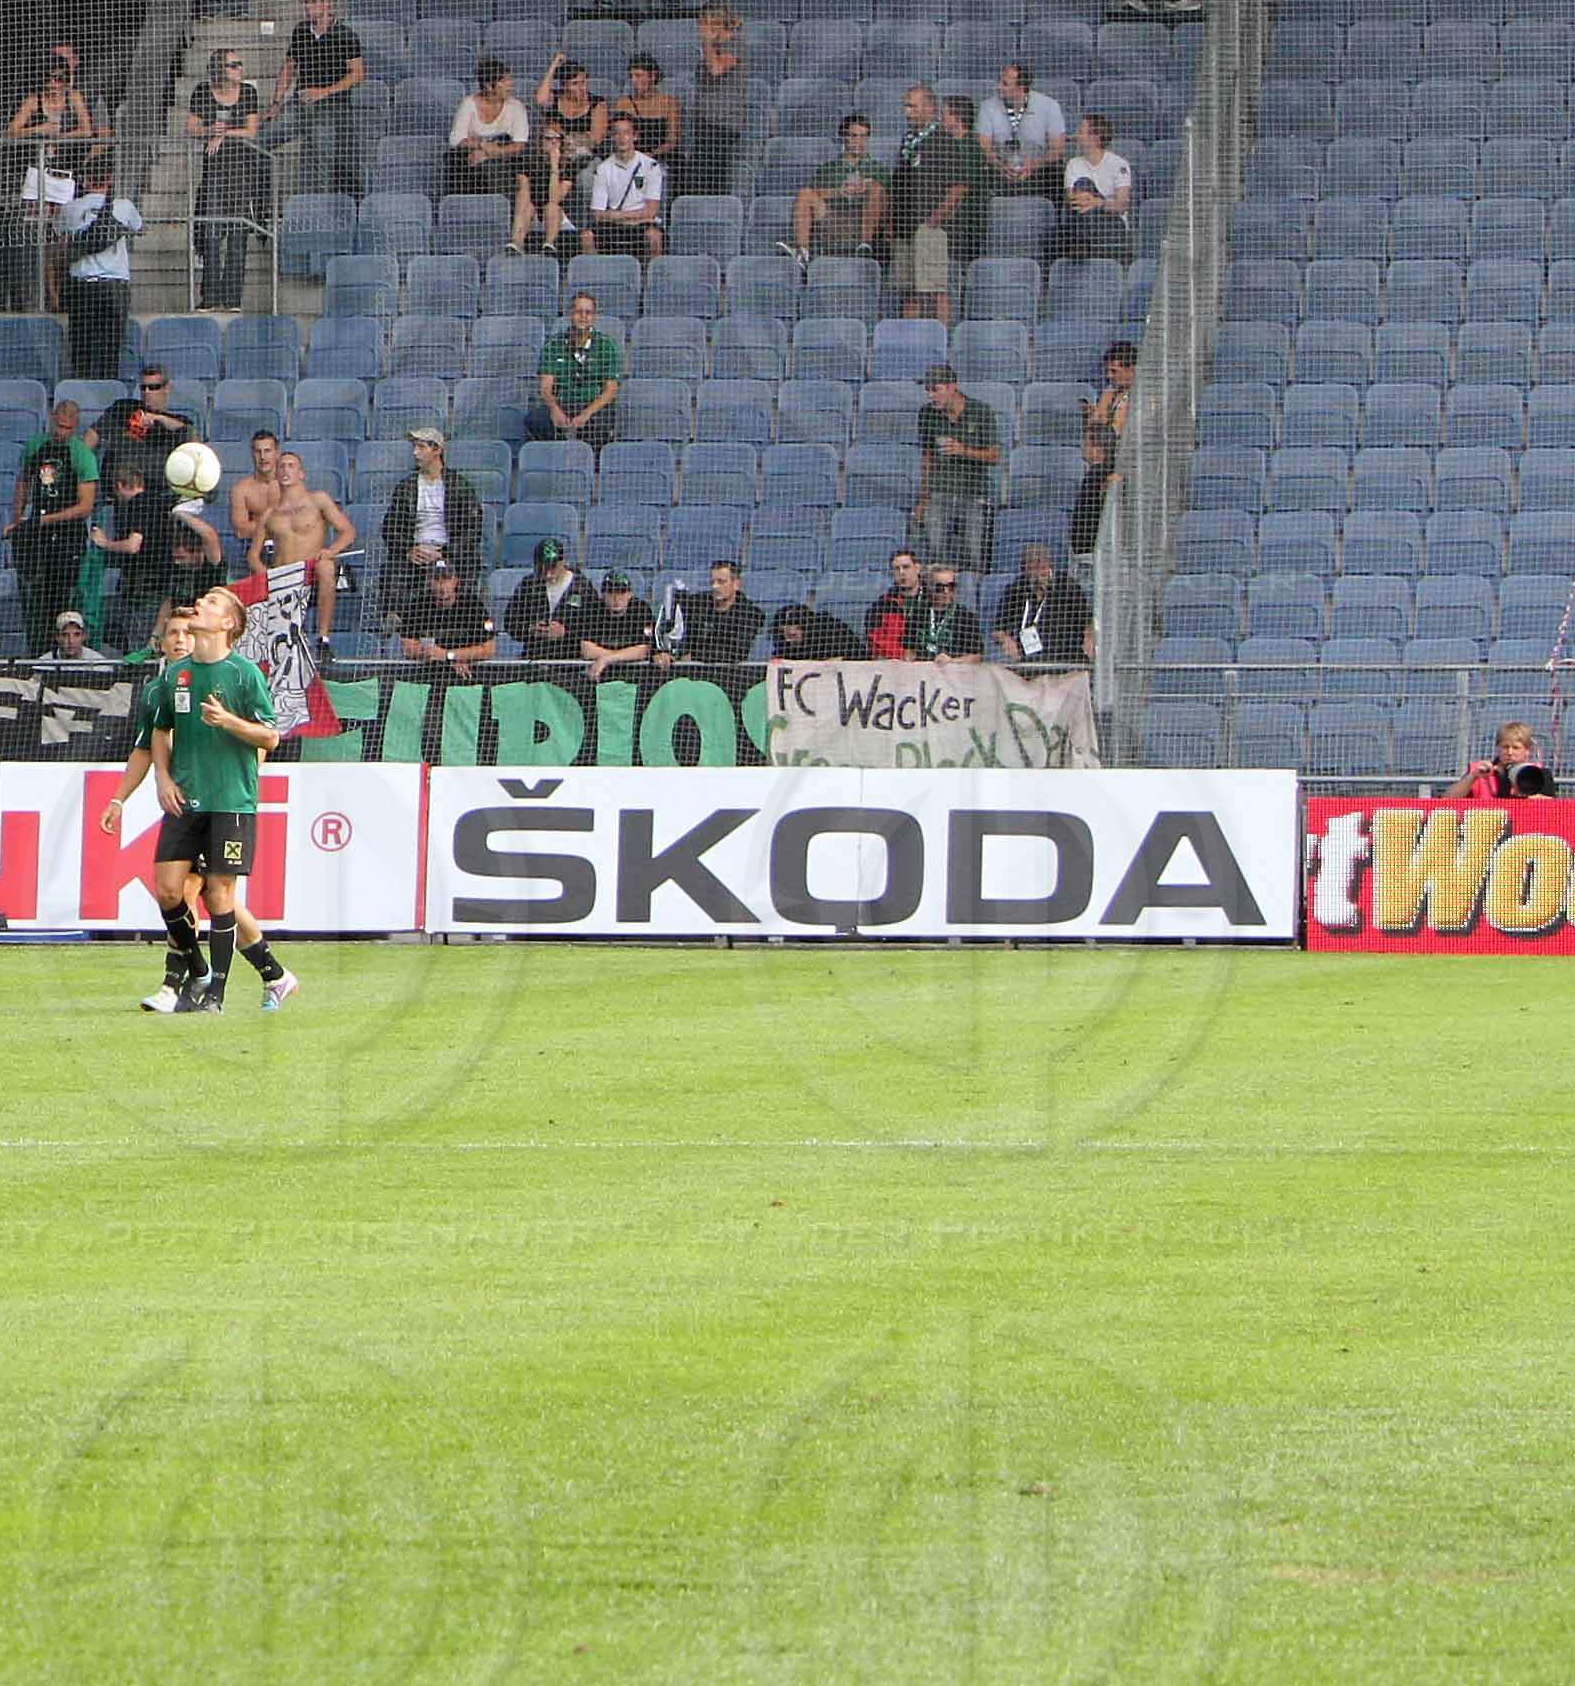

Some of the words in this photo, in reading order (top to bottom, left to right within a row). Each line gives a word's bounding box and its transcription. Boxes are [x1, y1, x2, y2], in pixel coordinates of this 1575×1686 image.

[776, 667, 821, 716] FC
[836, 670, 976, 731] Wacker
[451, 778, 1267, 927] ŠKODA
